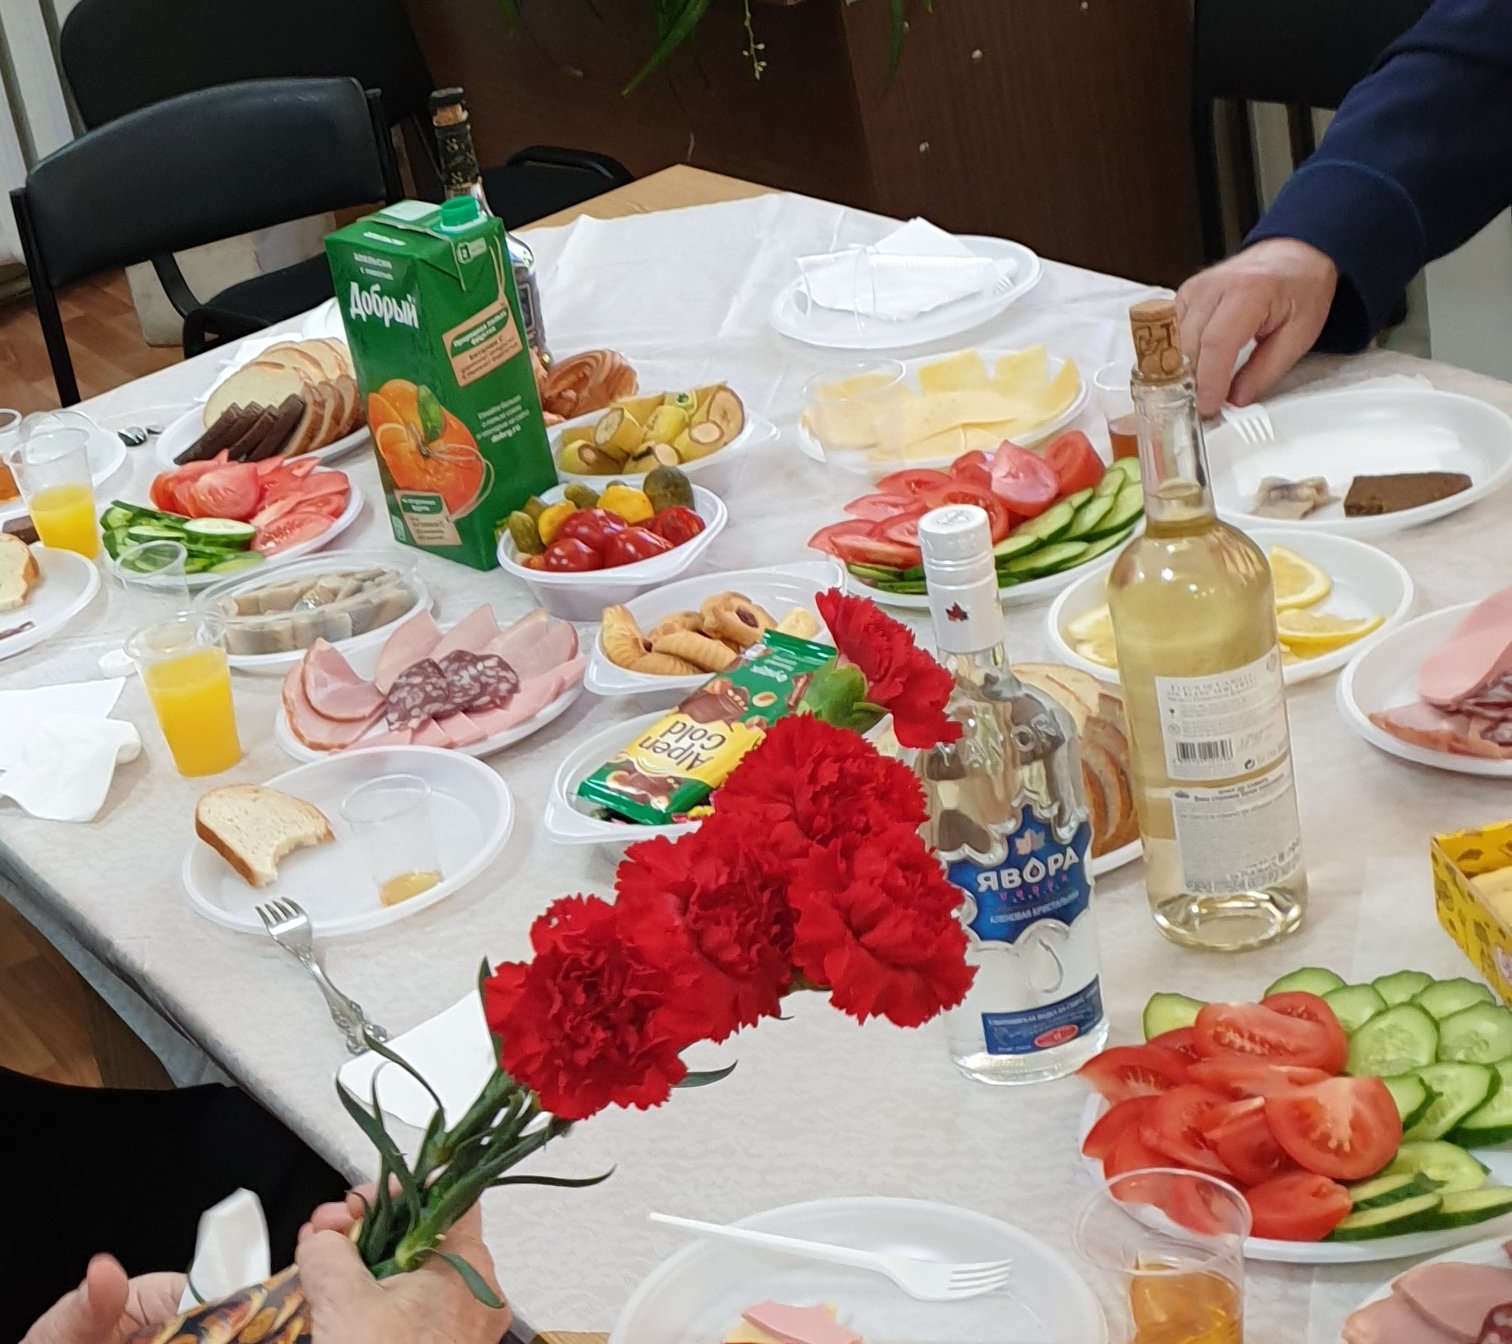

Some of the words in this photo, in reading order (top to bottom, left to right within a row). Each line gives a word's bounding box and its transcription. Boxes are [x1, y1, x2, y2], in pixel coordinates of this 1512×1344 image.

[349, 280, 420, 330] Добрый
[638, 735, 715, 772] Alpen
[668, 720, 727, 752] Gold
[976, 847, 1080, 893] ЯВОРА
